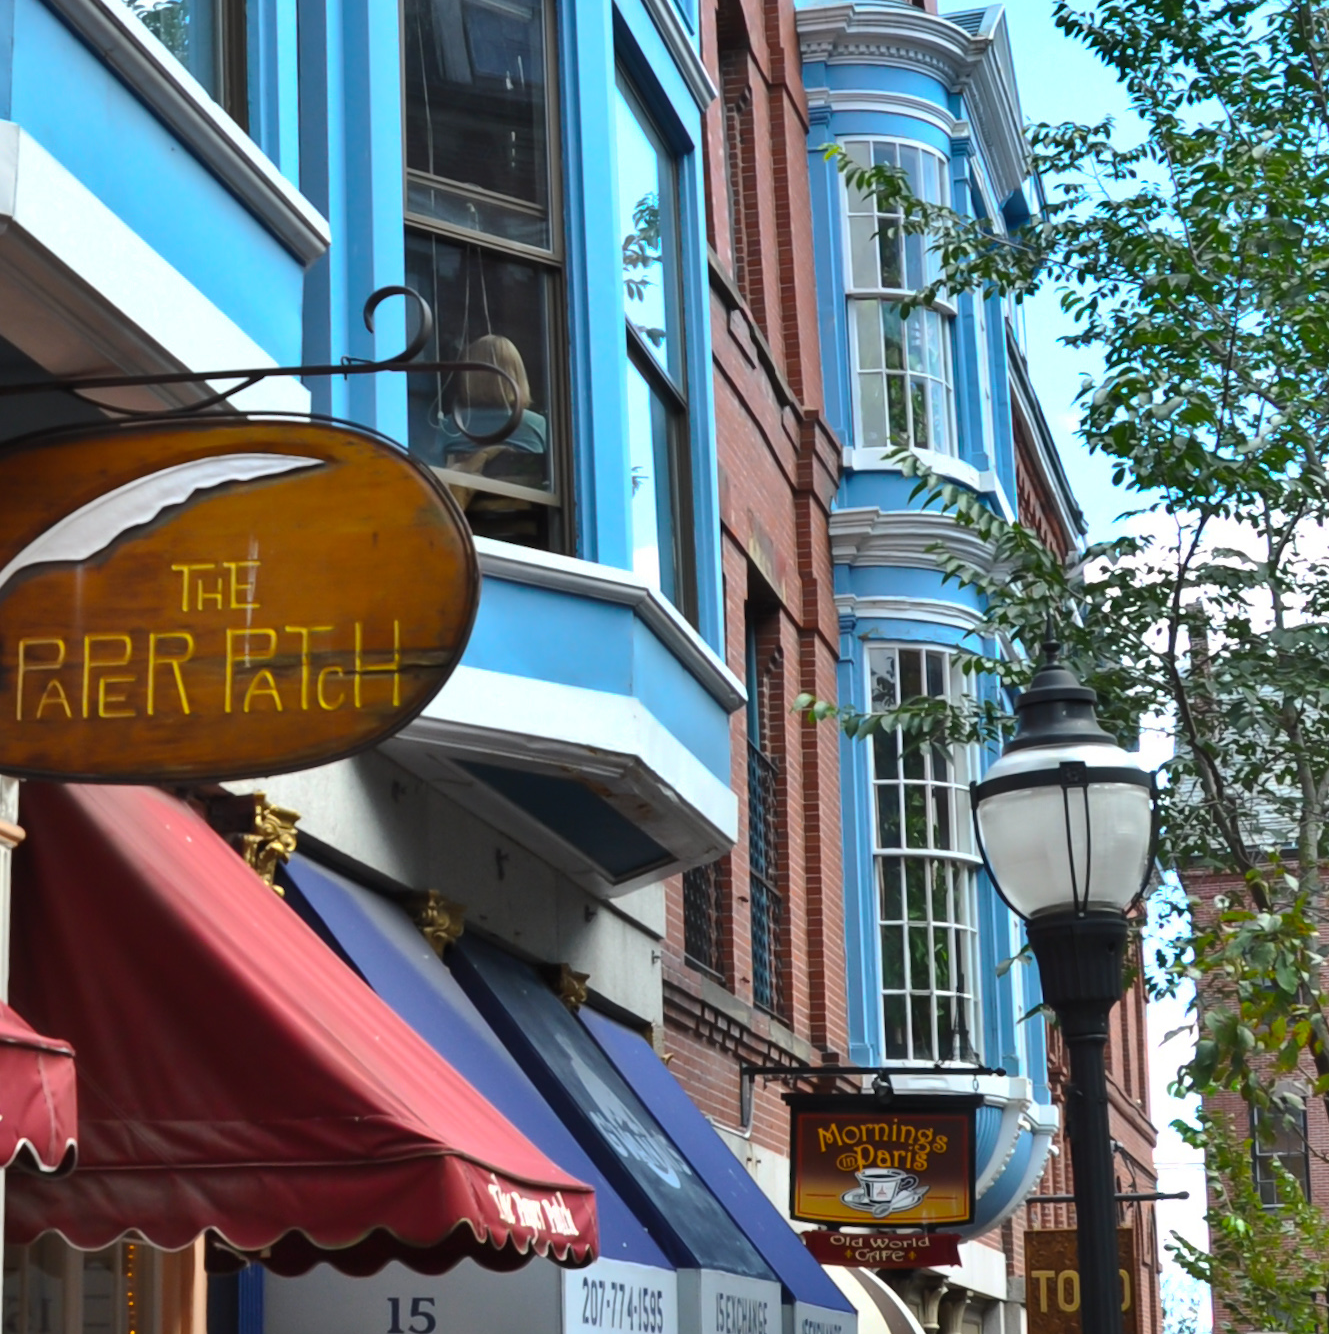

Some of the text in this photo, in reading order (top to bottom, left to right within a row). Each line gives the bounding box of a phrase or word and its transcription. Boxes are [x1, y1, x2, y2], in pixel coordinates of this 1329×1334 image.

[172, 561, 260, 611] THE
[16, 619, 401, 721] PAPER PATCH
[817, 1118, 948, 1153] Mornings
[854, 1144, 927, 1172] Paris
[488, 1173, 515, 1224] The
[541, 1191, 579, 1236] Patch
[830, 1235, 930, 1248] Old World
[387, 1297, 436, 1334] 15
[582, 1277, 663, 1334] 207-774-1595
